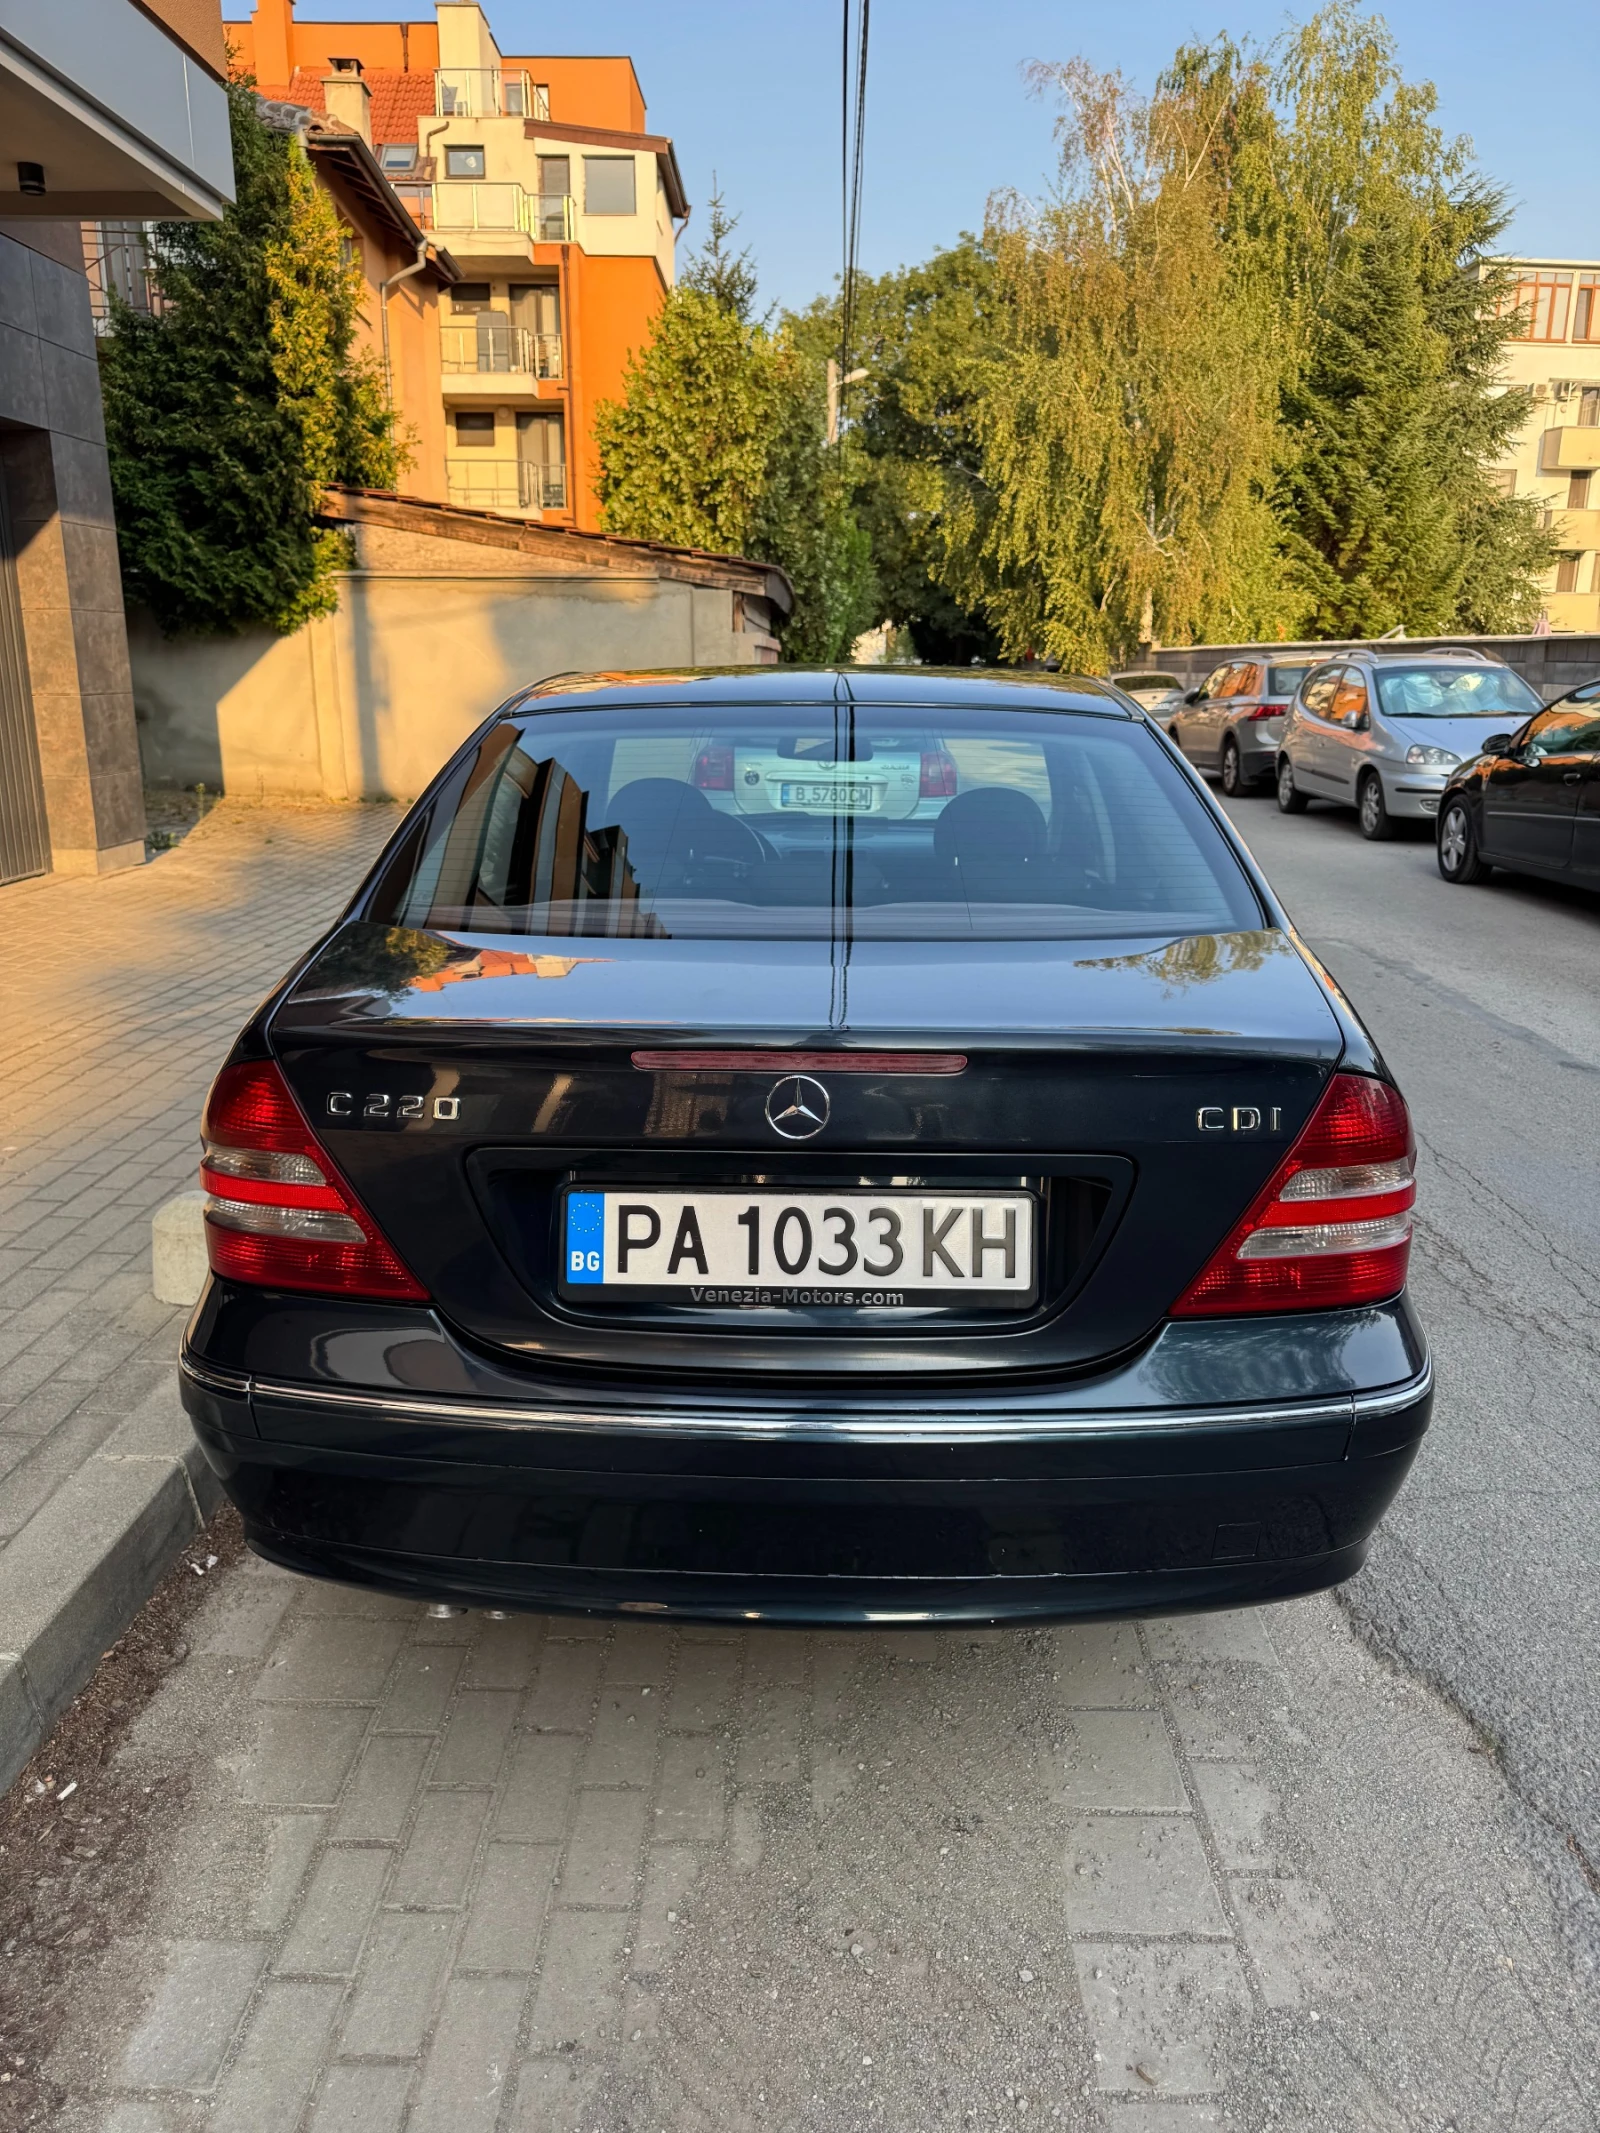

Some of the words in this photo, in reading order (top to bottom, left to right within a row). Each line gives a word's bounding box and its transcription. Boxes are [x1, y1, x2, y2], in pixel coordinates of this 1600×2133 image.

[812, 787, 847, 803] 5780
[326, 1092, 352, 1116] C
[363, 1093, 461, 1121] 220
[1196, 1106, 1282, 1131] CDI
[617, 1205, 709, 1274] PA
[737, 1206, 903, 1277] 1033
[922, 1208, 1016, 1278] KH
[571, 1251, 600, 1271] BG
[690, 1287, 904, 1305] Venezia-Motors.com
